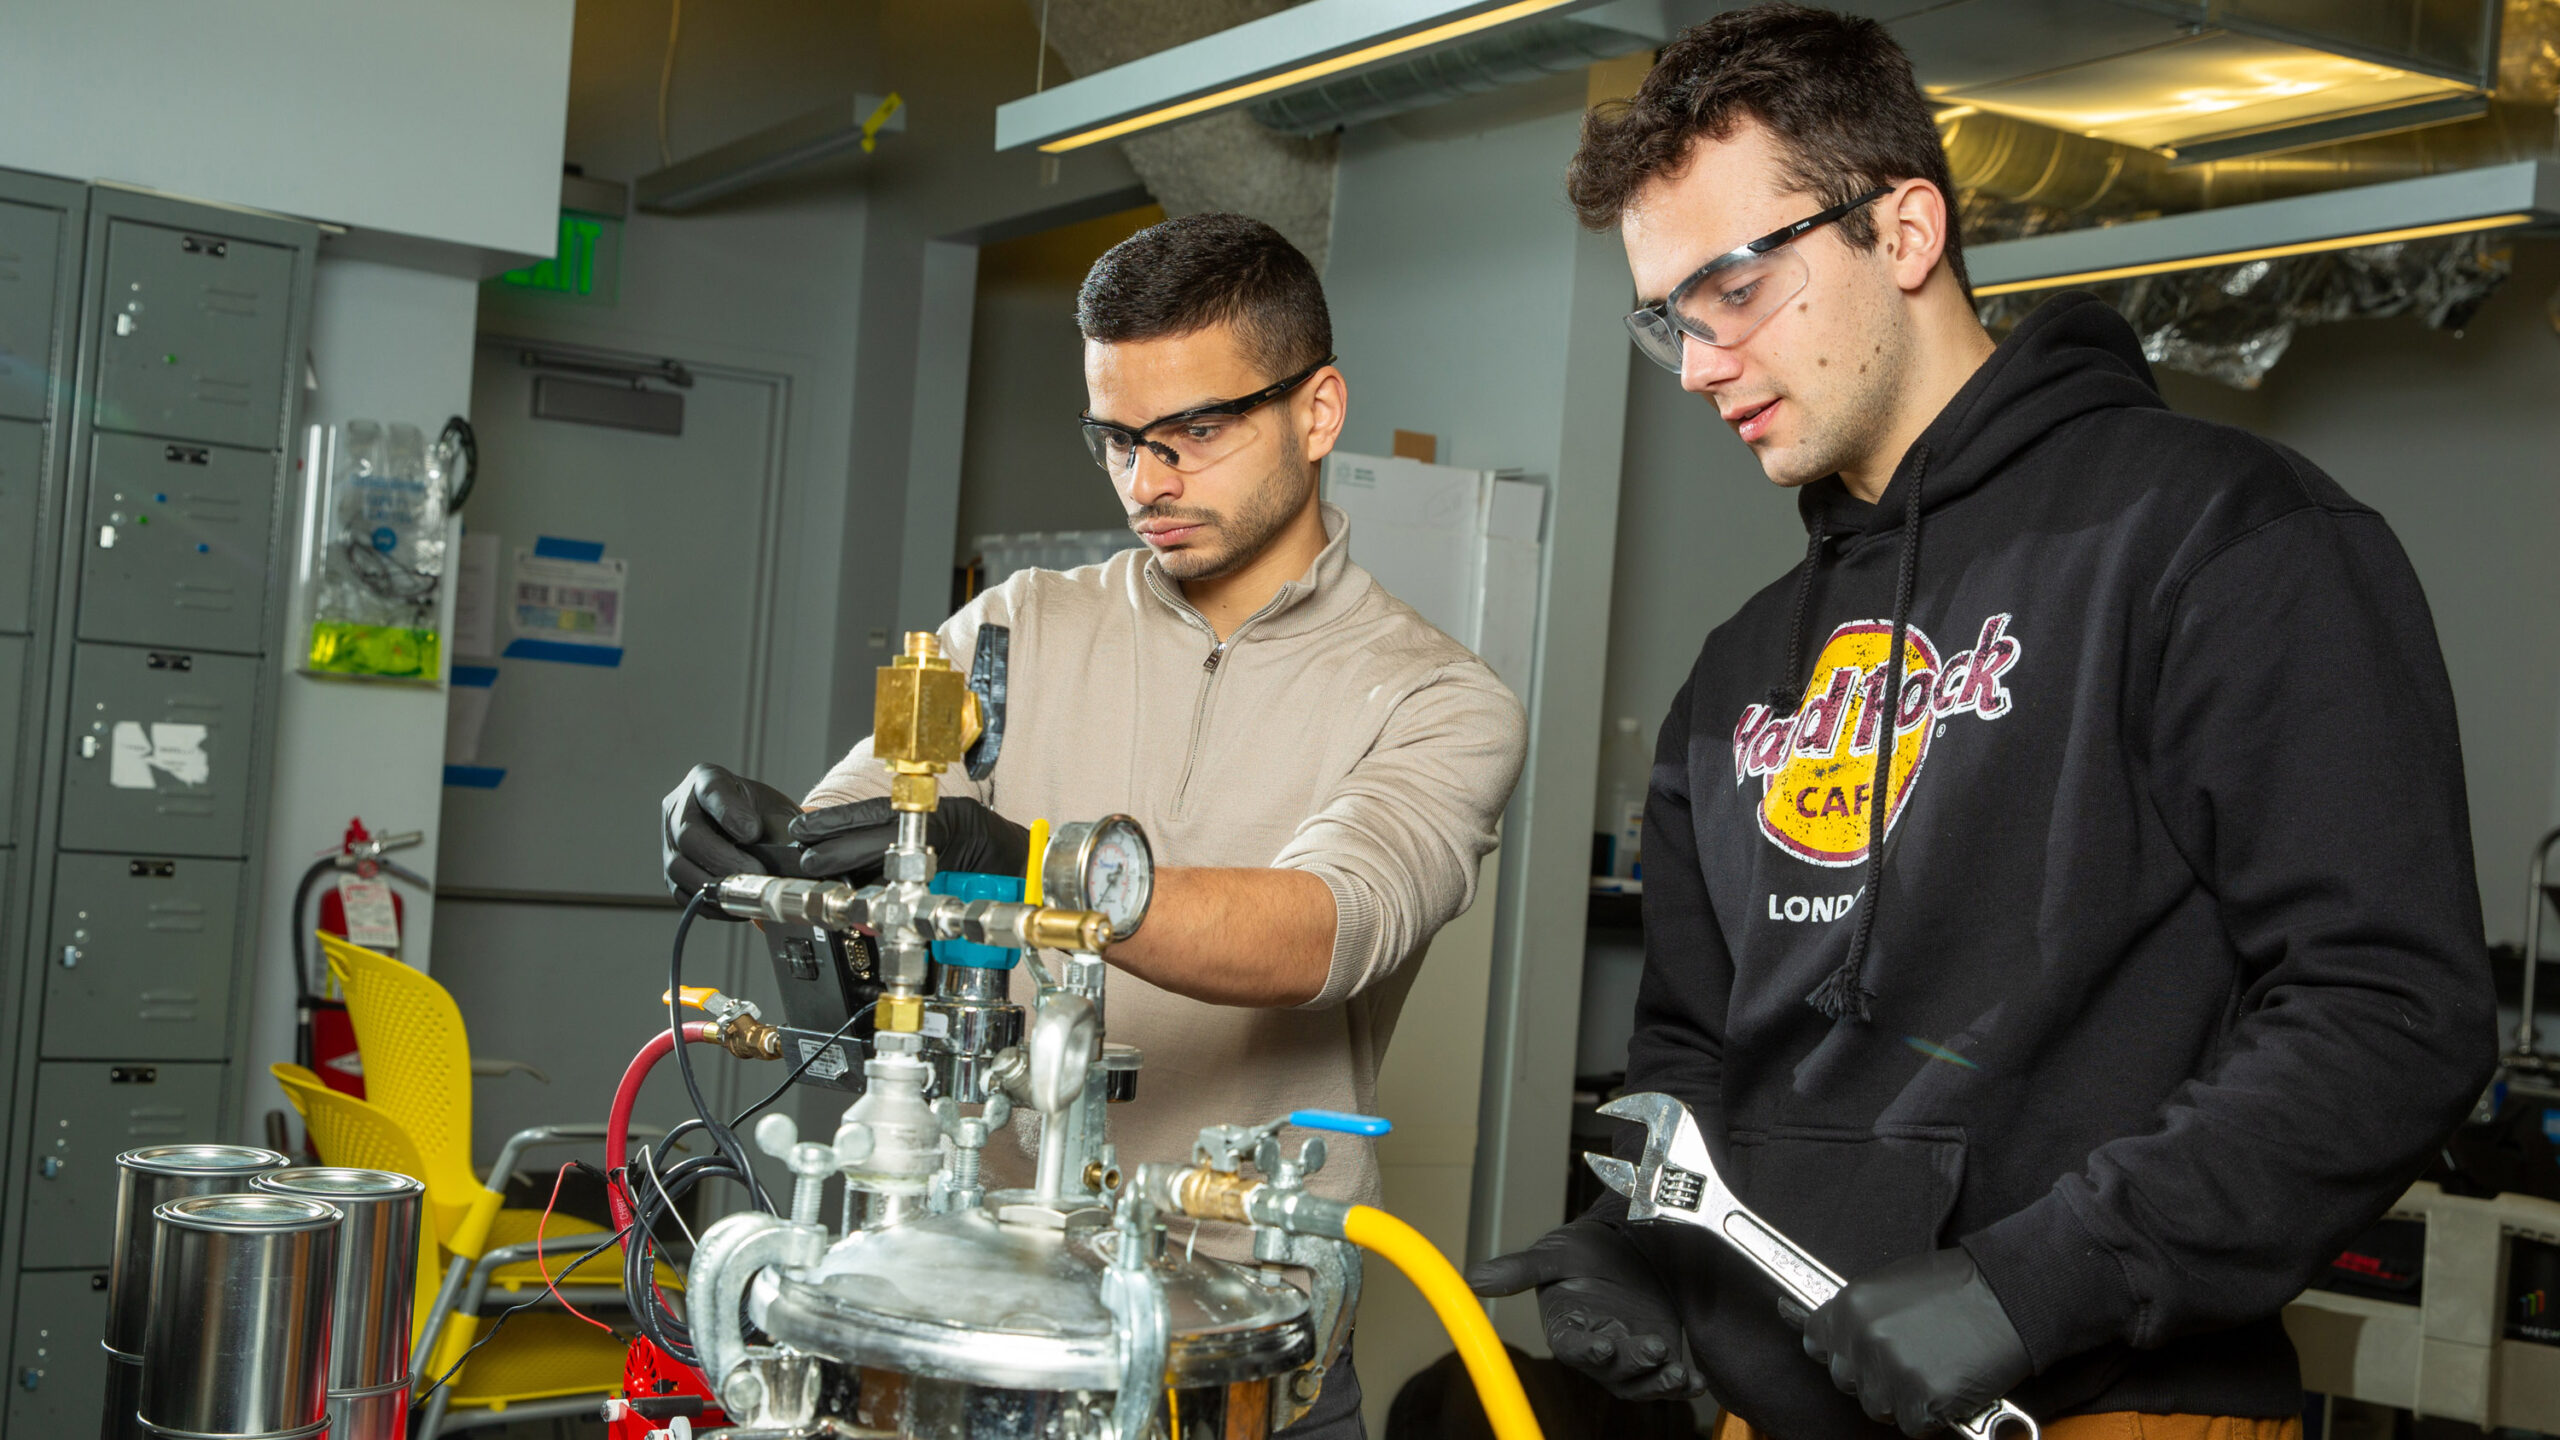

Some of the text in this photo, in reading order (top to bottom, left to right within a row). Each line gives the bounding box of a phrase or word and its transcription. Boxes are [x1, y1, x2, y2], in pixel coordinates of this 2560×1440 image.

[1733, 666, 1861, 786] Had
[1796, 783, 1870, 818] CAF
[1769, 885, 1865, 922] LOND
